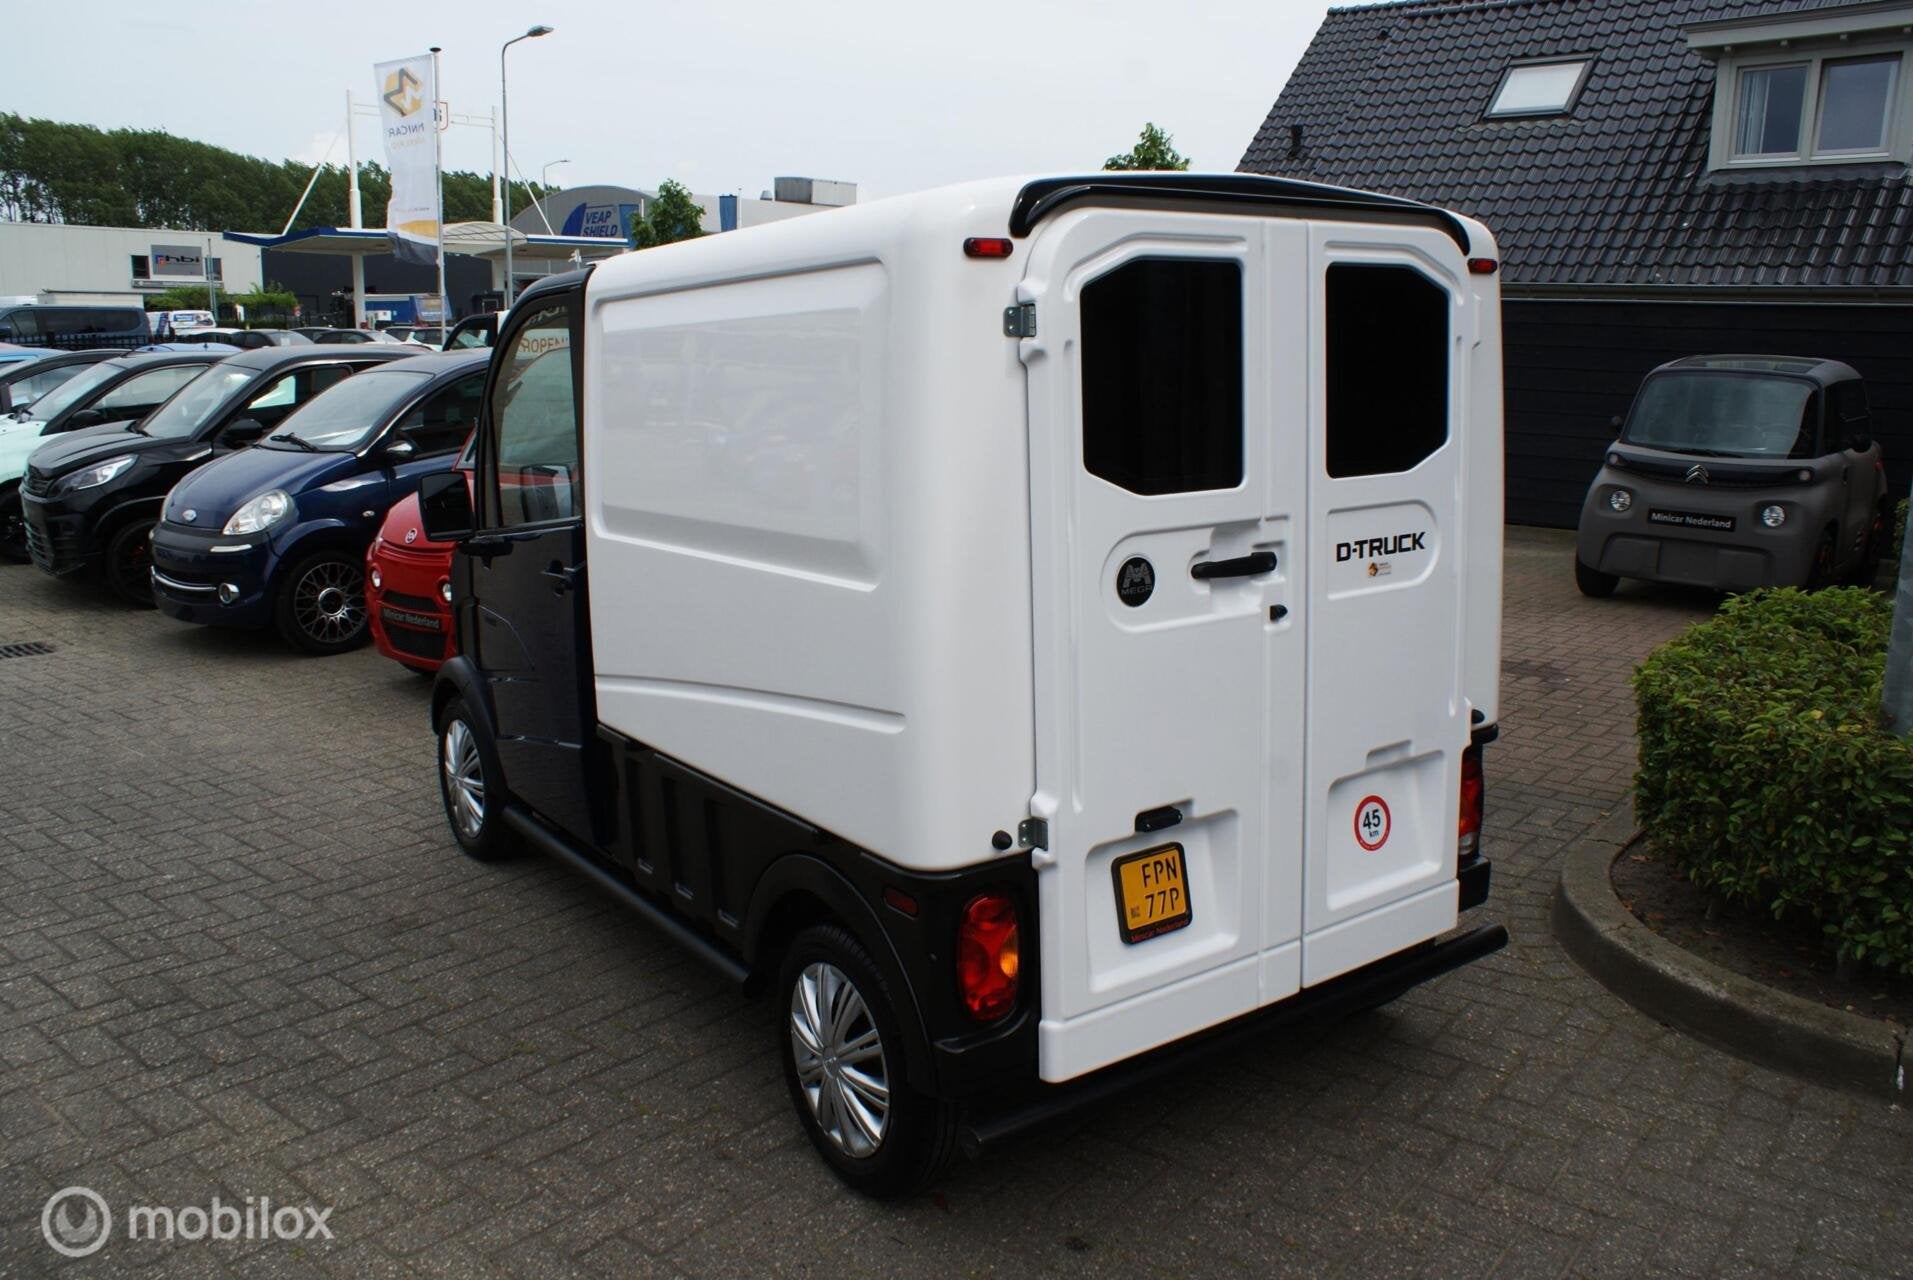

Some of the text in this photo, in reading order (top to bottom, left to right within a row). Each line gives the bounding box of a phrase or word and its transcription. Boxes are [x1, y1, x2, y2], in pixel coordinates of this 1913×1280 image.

[585, 211, 612, 224] VEAP
[583, 225, 618, 237] SHIELD
[1651, 512, 1732, 528] Minicar Nederland
[1336, 531, 1426, 562] D-TRUCK
[1363, 809, 1381, 829] 45
[1141, 856, 1177, 888] FPN
[1145, 887, 1179, 918] 77P
